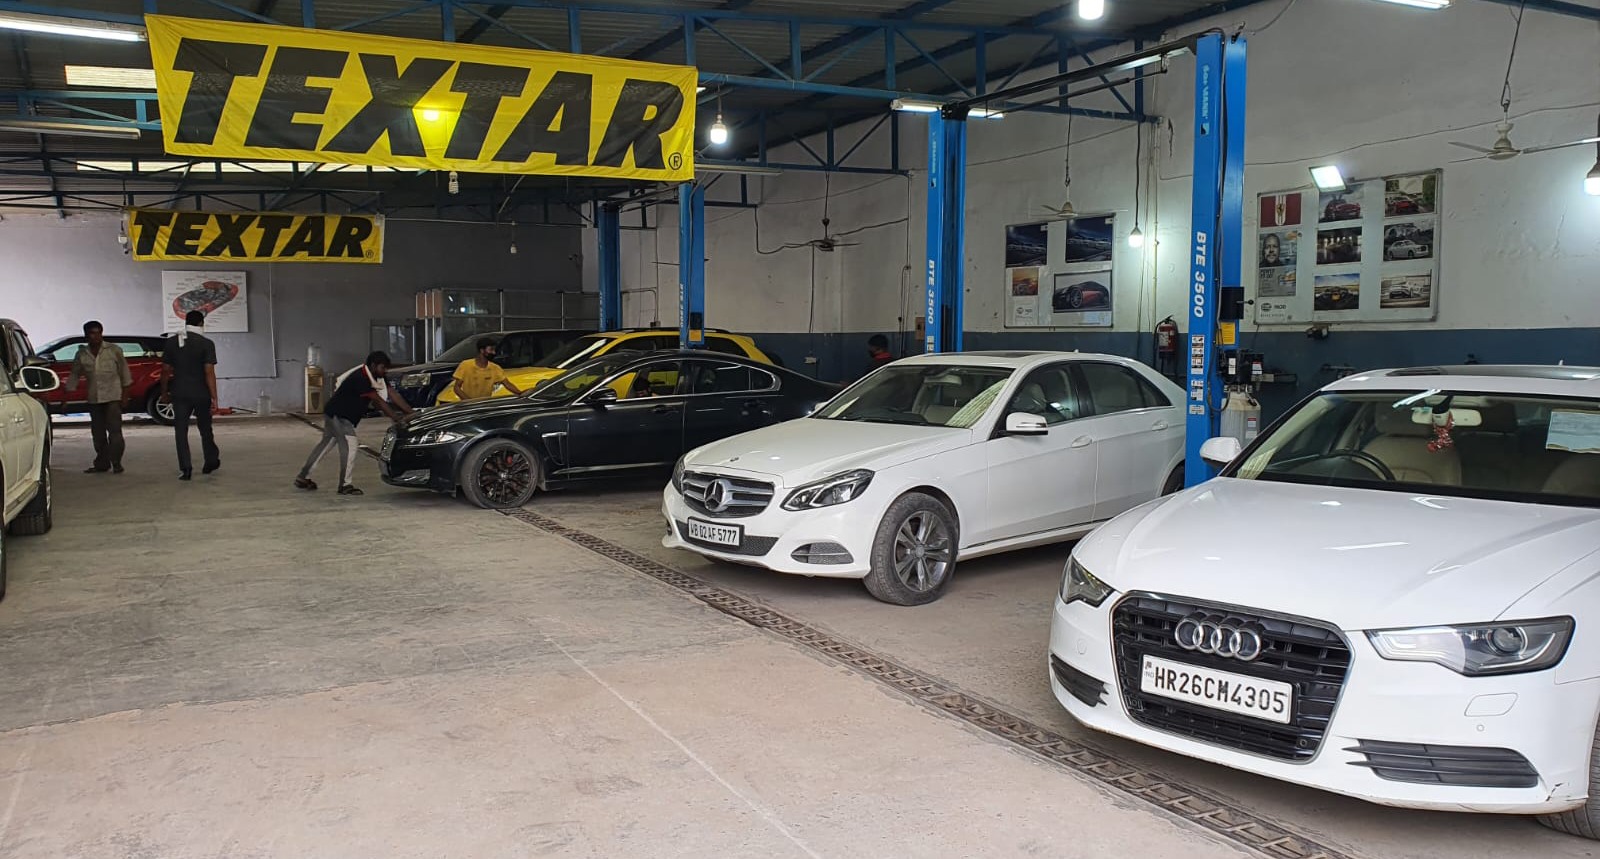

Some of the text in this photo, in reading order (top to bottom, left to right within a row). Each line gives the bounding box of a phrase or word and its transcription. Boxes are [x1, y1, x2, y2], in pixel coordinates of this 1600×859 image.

[172, 37, 684, 170] TEXTAR
[132, 212, 373, 258] TEXTAR
[1194, 231, 1207, 318] BTE 3500
[927, 289, 935, 325] 3500
[717, 528, 737, 543] 5777
[1154, 666, 1285, 714] HR26CM4305
